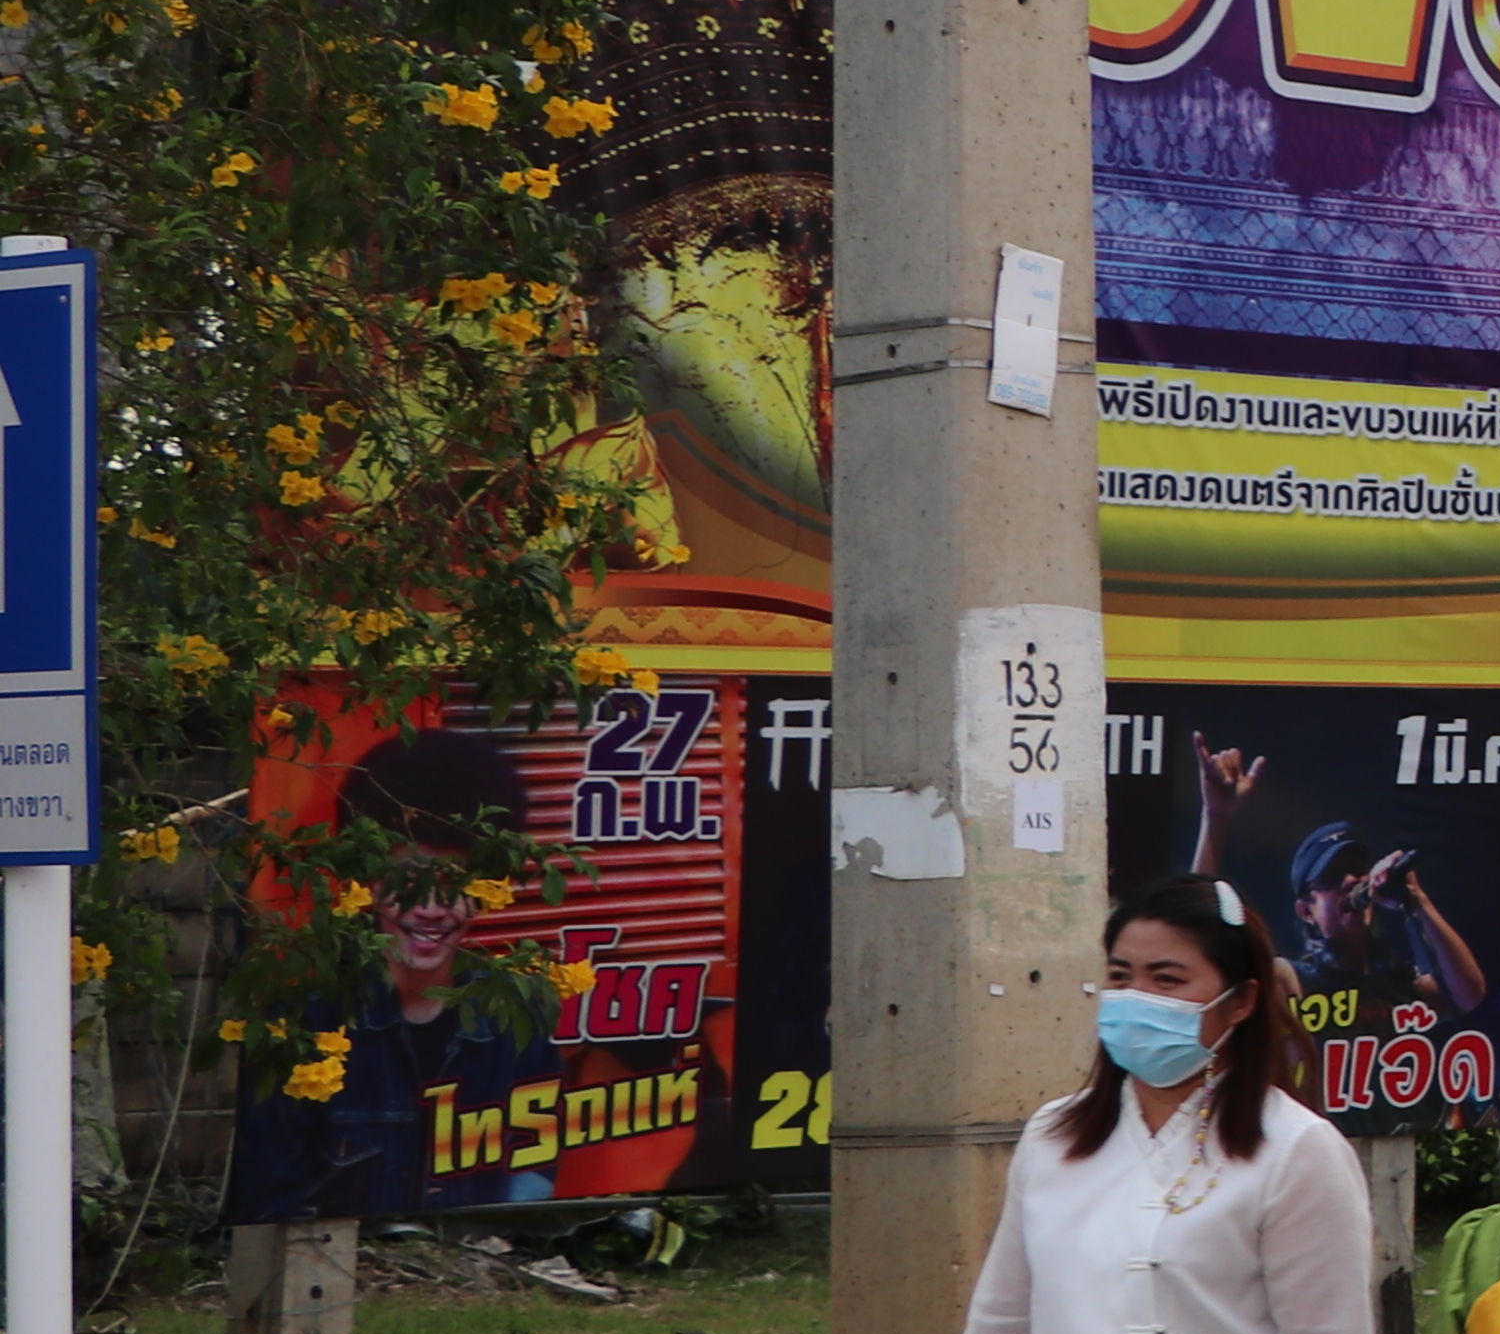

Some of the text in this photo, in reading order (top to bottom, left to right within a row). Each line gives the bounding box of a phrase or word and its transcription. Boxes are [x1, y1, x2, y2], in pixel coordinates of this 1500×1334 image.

[1002, 658, 1063, 709] 133
[585, 687, 715, 777] 27
[1008, 725, 1059, 775] 56
[572, 775, 721, 842] ก.พ.
[1020, 811, 1053, 831] AIS
